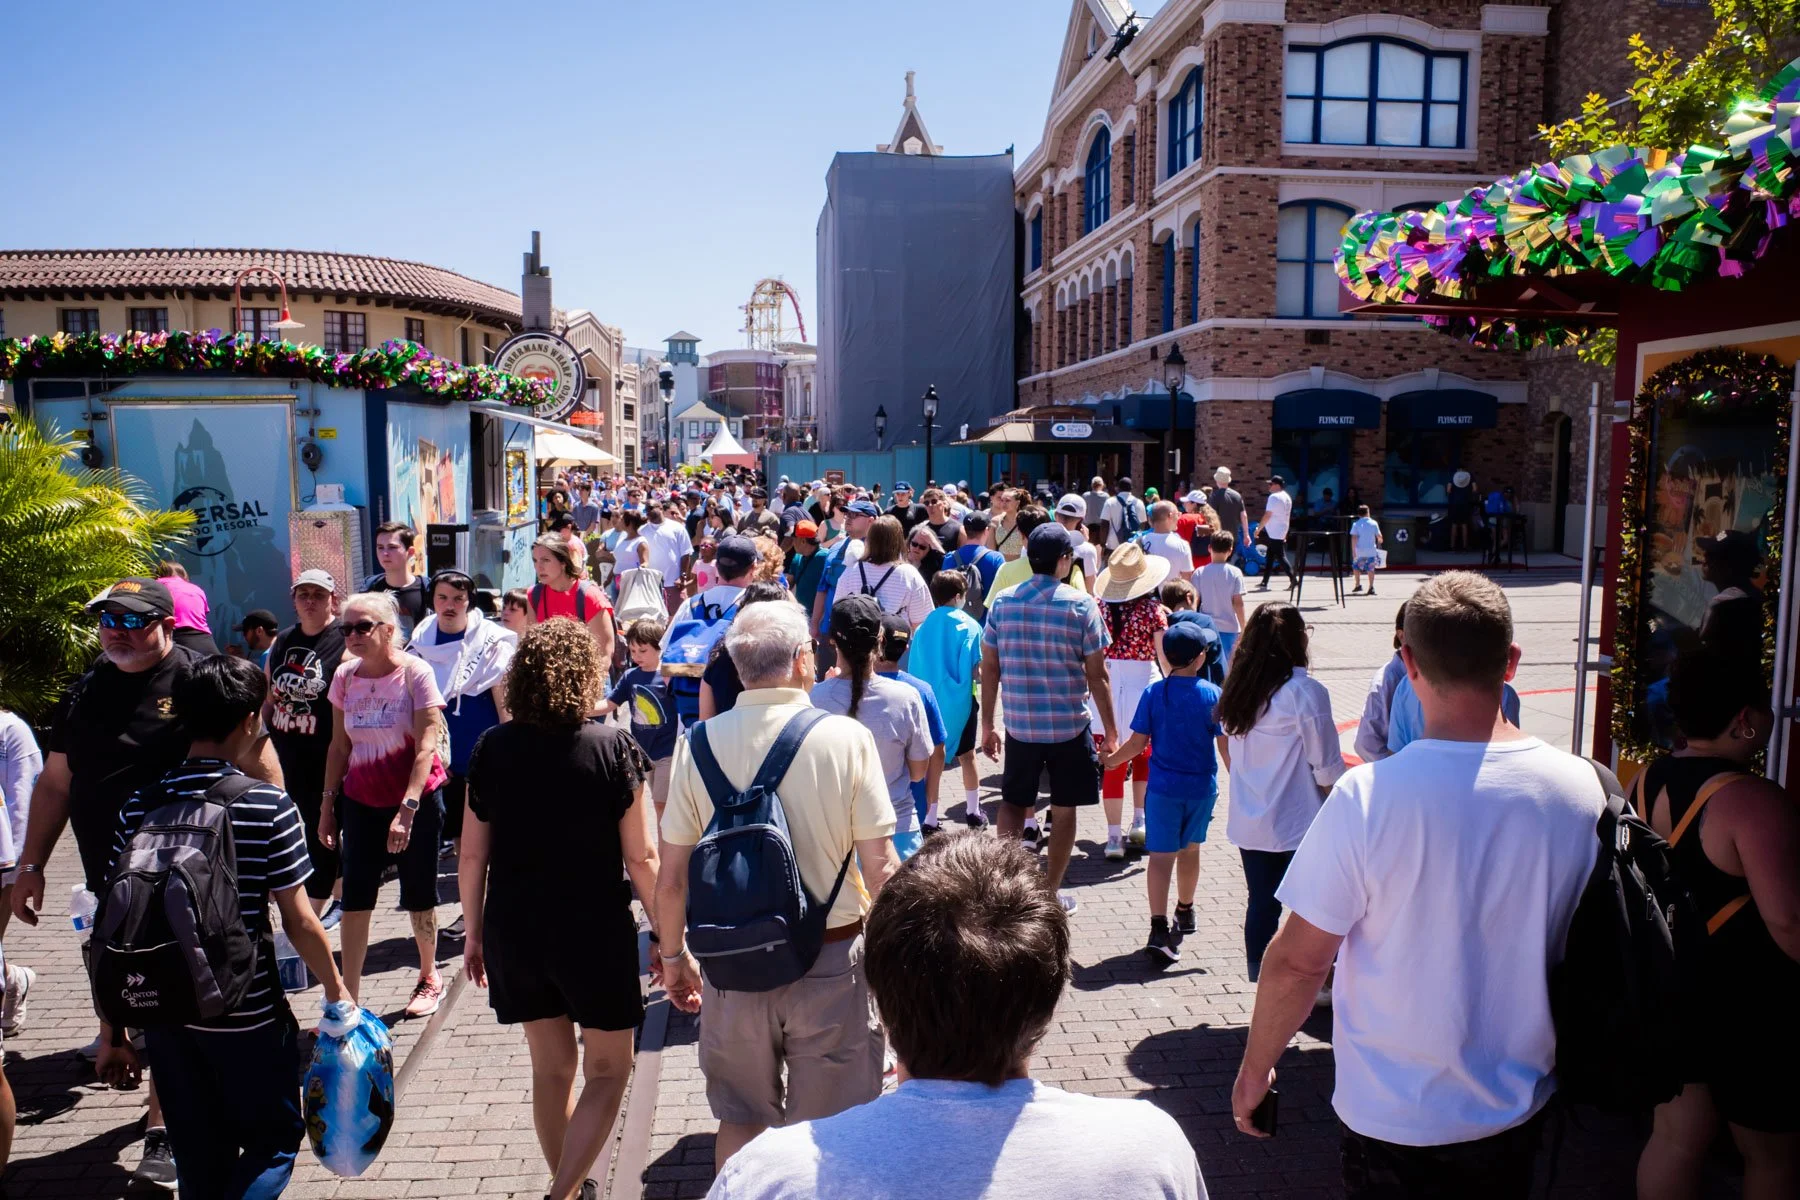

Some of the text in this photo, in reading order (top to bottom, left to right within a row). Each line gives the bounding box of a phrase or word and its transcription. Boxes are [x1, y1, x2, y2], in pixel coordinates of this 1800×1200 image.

[503, 343, 572, 378] ISHERMANS WHARF
[534, 385, 571, 413] RANCISCO
[1318, 416, 1338, 424] FLYING
[1437, 415, 1457, 424] FLYING
[194, 500, 268, 524] ERSAL
[216, 518, 258, 532] RESORT
